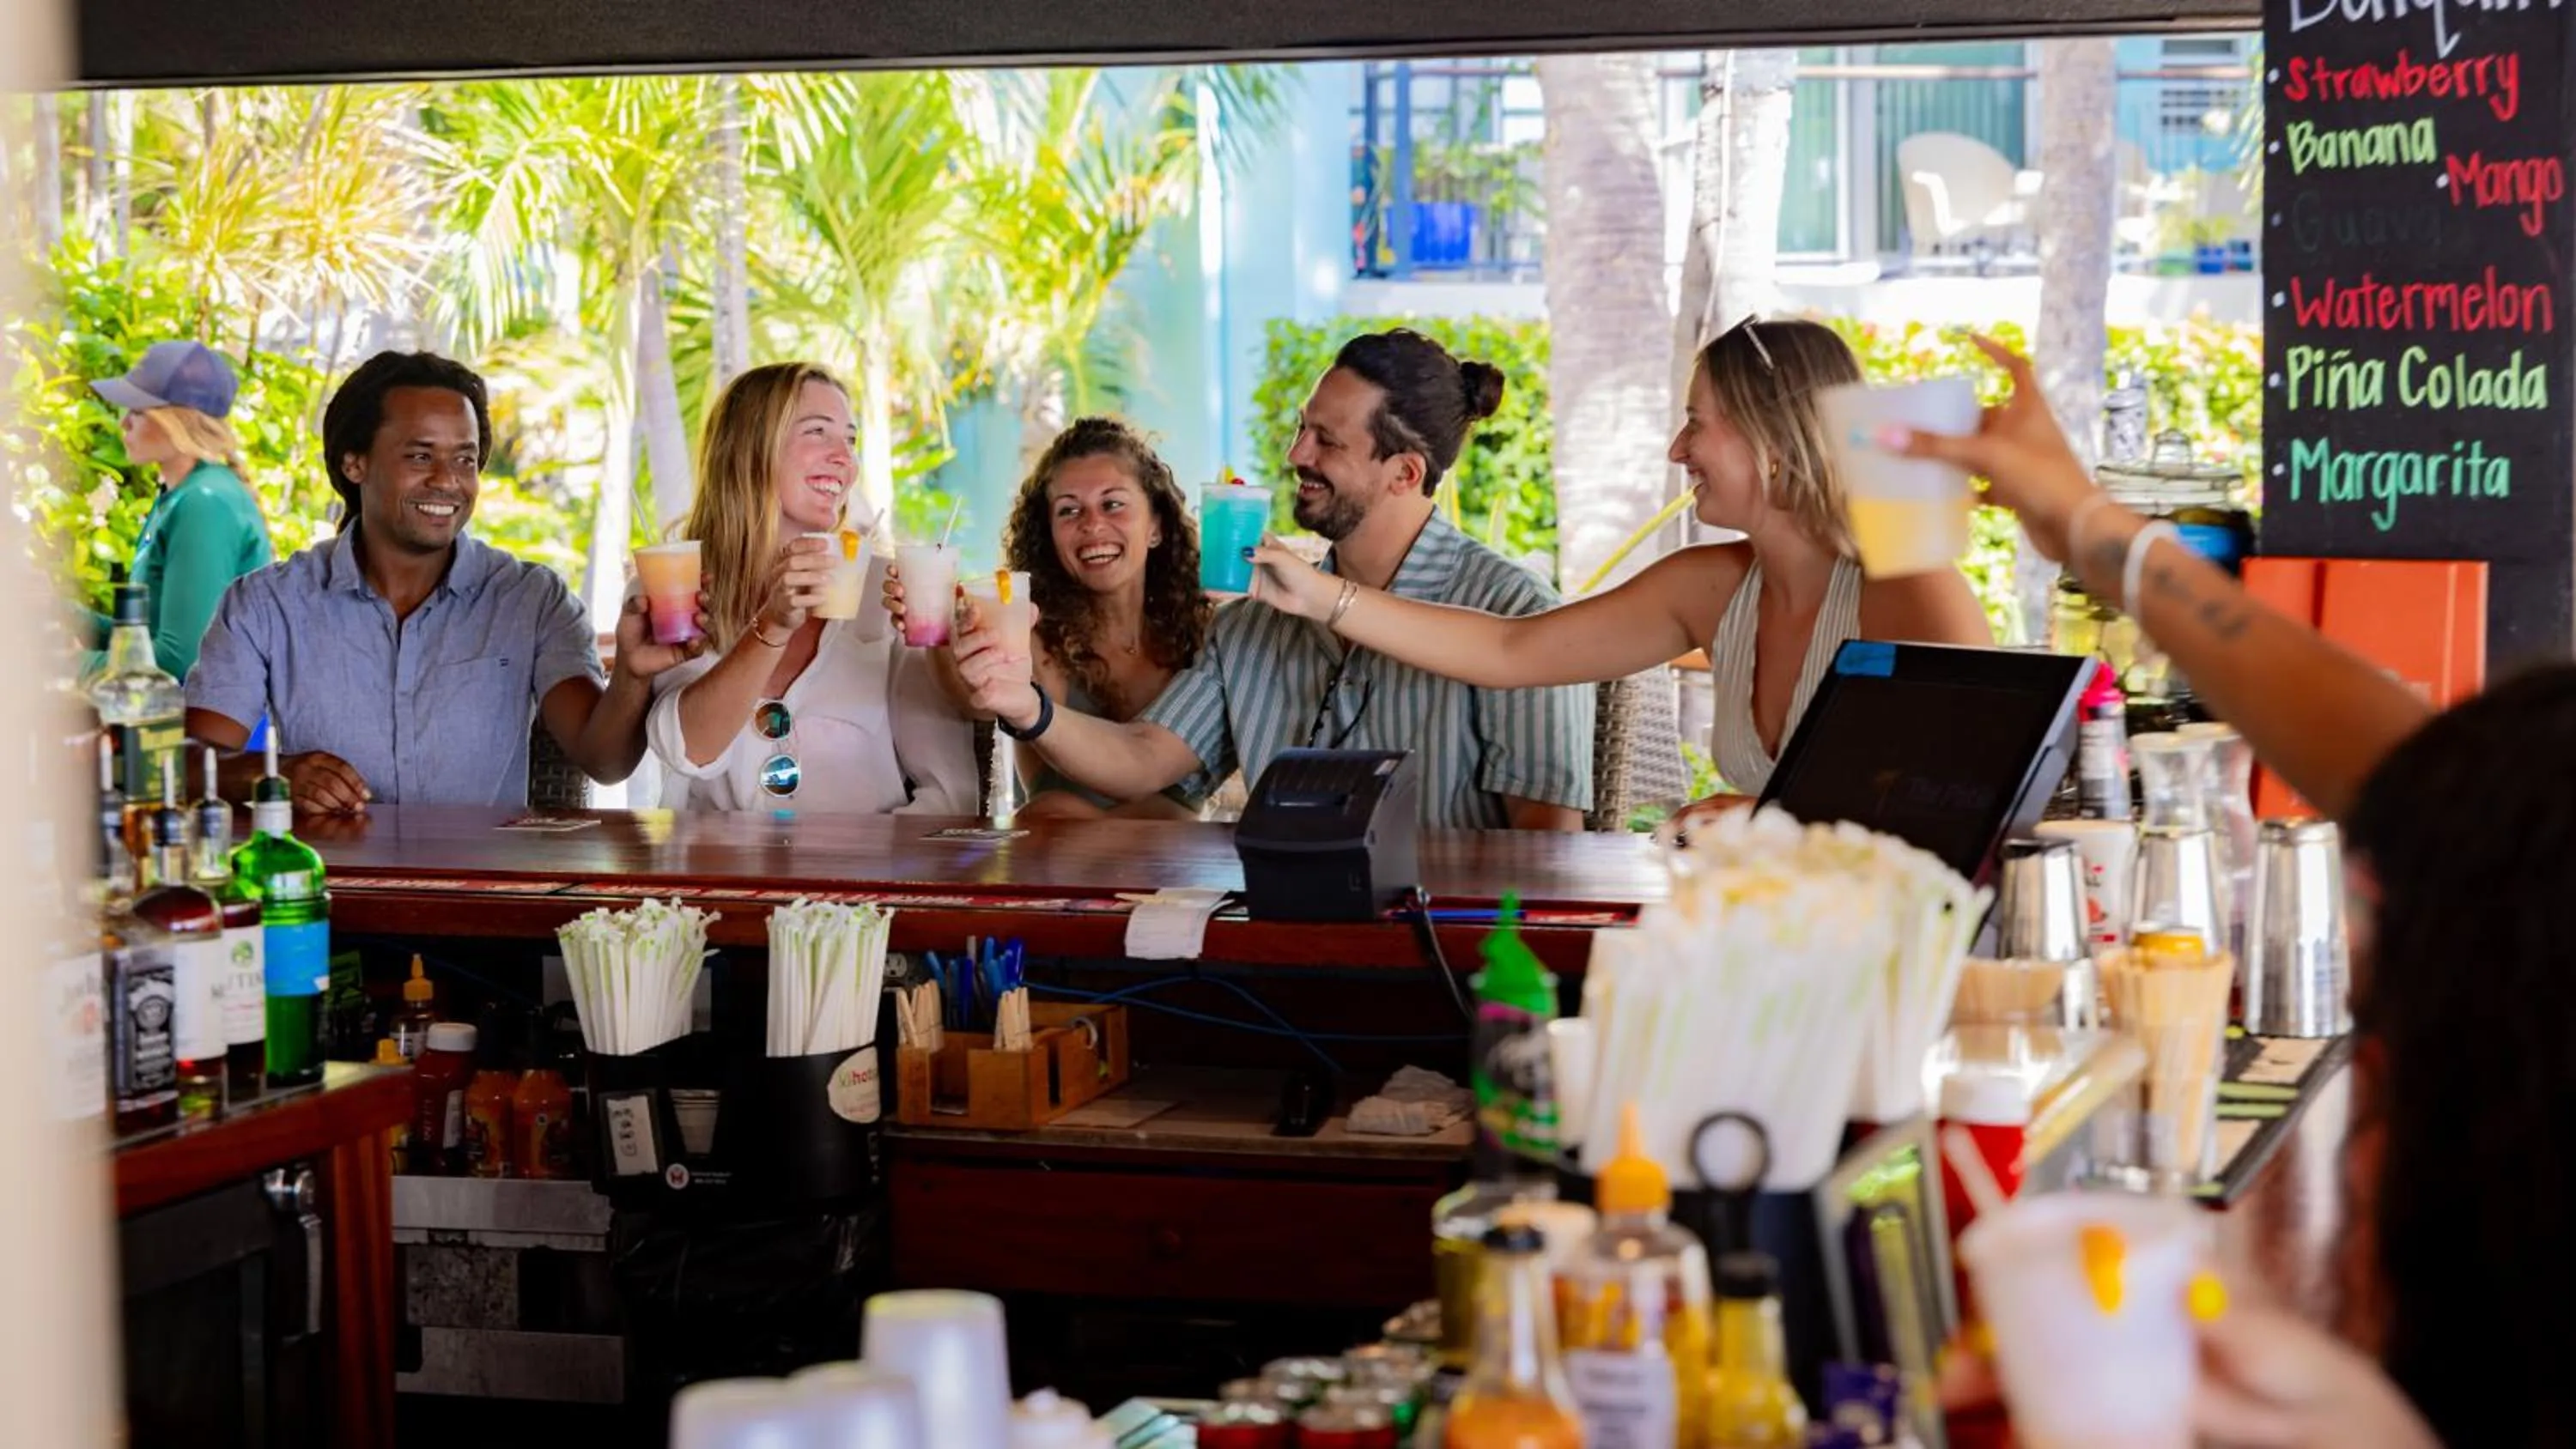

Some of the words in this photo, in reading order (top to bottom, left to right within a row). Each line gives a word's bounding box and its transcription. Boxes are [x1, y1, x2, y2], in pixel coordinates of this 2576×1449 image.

[2283, 48, 2519, 122] Strawberry
[2286, 117, 2437, 174] Banana
[2445, 152, 2565, 237] Mango
[2290, 266, 2554, 333] Watermelon
[2286, 345, 2385, 411] Piña
[2397, 345, 2549, 411] Colada
[2290, 437, 2511, 531] Margarita
